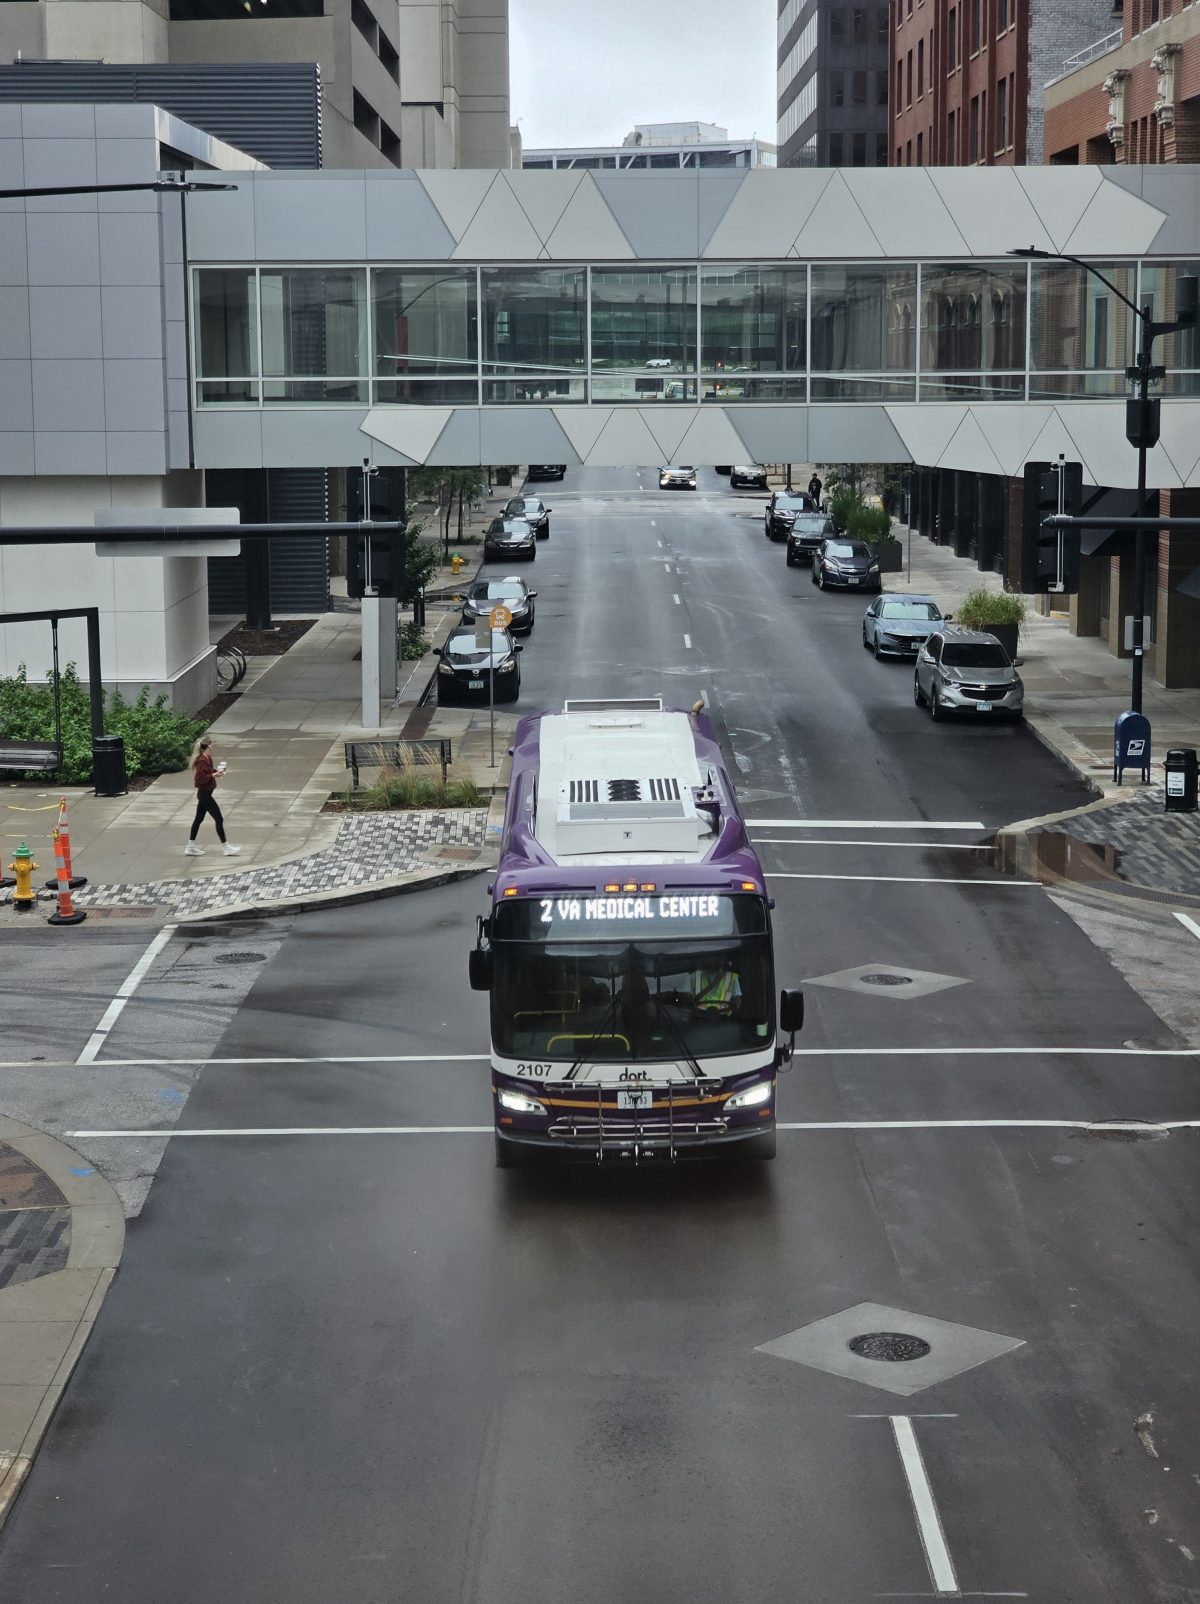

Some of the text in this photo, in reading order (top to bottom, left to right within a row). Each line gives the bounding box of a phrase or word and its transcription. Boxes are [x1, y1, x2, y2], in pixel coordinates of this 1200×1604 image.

[540, 896, 719, 922] 2 VA MEDICAL CENTER
[517, 1064, 552, 1077] 2107
